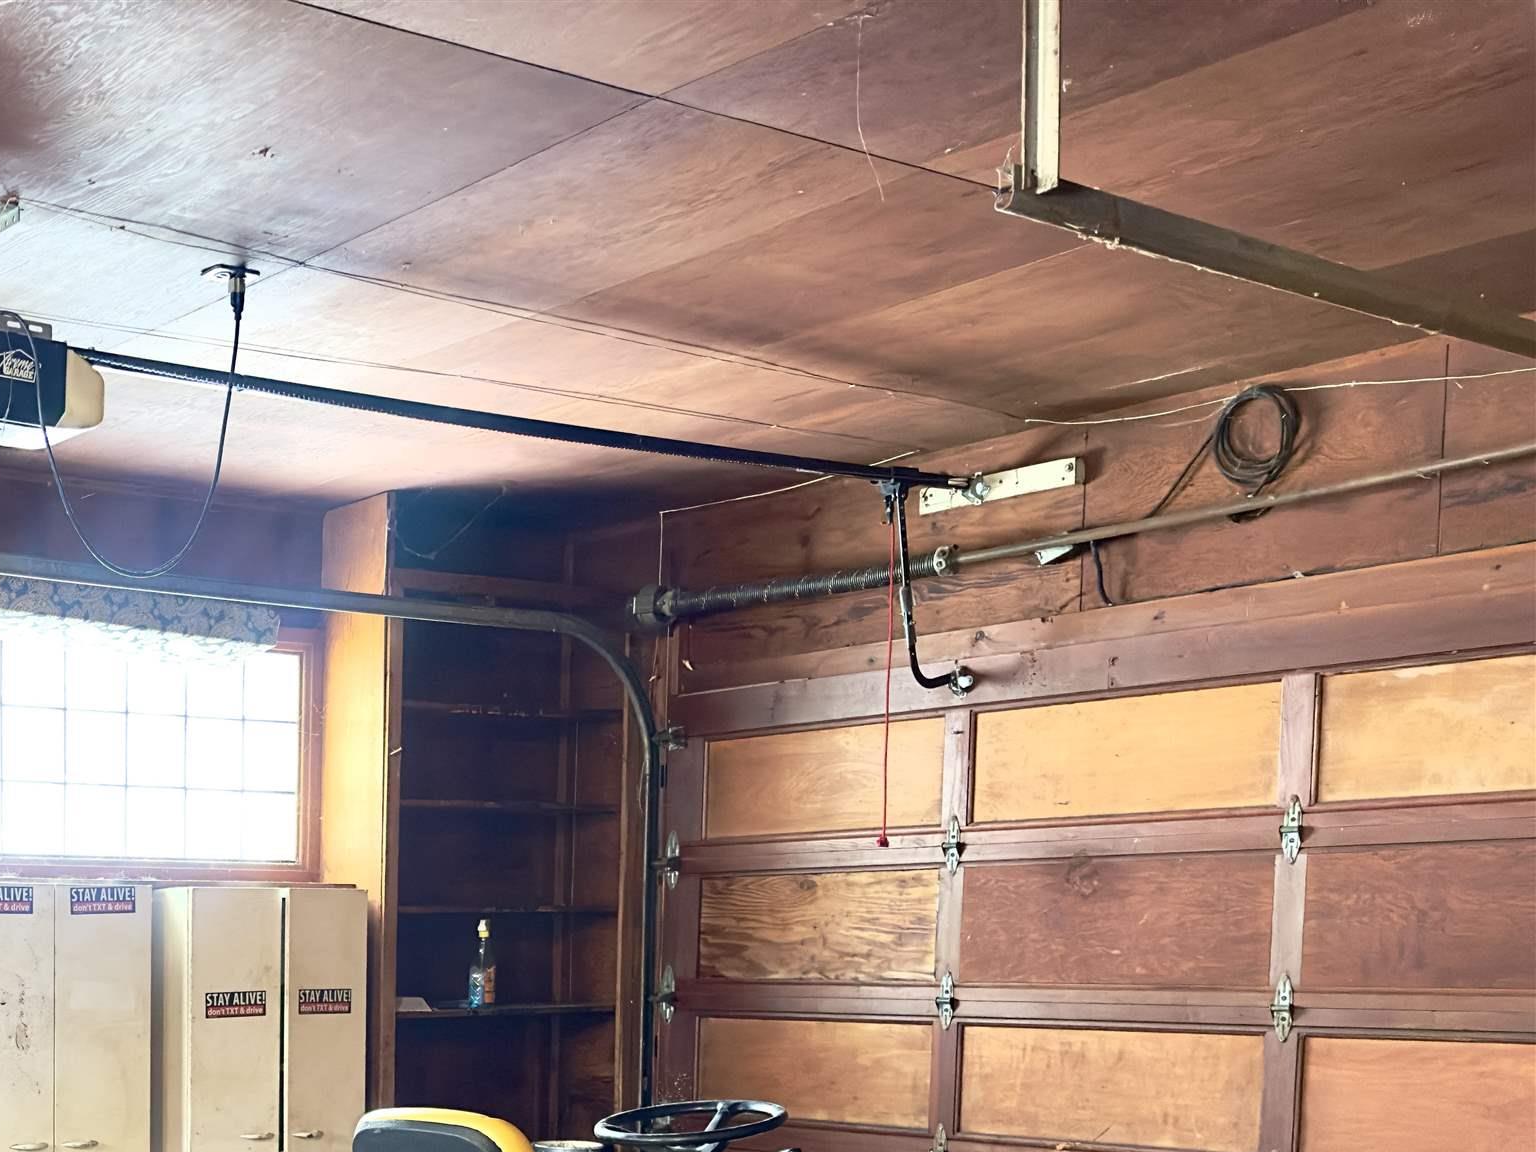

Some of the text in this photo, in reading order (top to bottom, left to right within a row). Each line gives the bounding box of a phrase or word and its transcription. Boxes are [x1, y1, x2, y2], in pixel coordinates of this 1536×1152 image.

[4, 366, 34, 379] GARAGE
[71, 888, 135, 902] STAY ALIVE!
[3, 903, 10, 911] &
[10, 902, 30, 912] drive
[92, 903, 106, 911] TXT
[107, 902, 114, 911] &
[114, 902, 133, 911] drive
[206, 991, 266, 1006] STAY ALIVE!
[299, 990, 352, 1003] STAY ALIVE!
[226, 1007, 239, 1015] TXT
[239, 1007, 246, 1015] &
[246, 1006, 264, 1014] drive
[315, 1004, 328, 1012] TXT
[328, 1004, 333, 1012] &
[333, 1004, 349, 1012] drive
